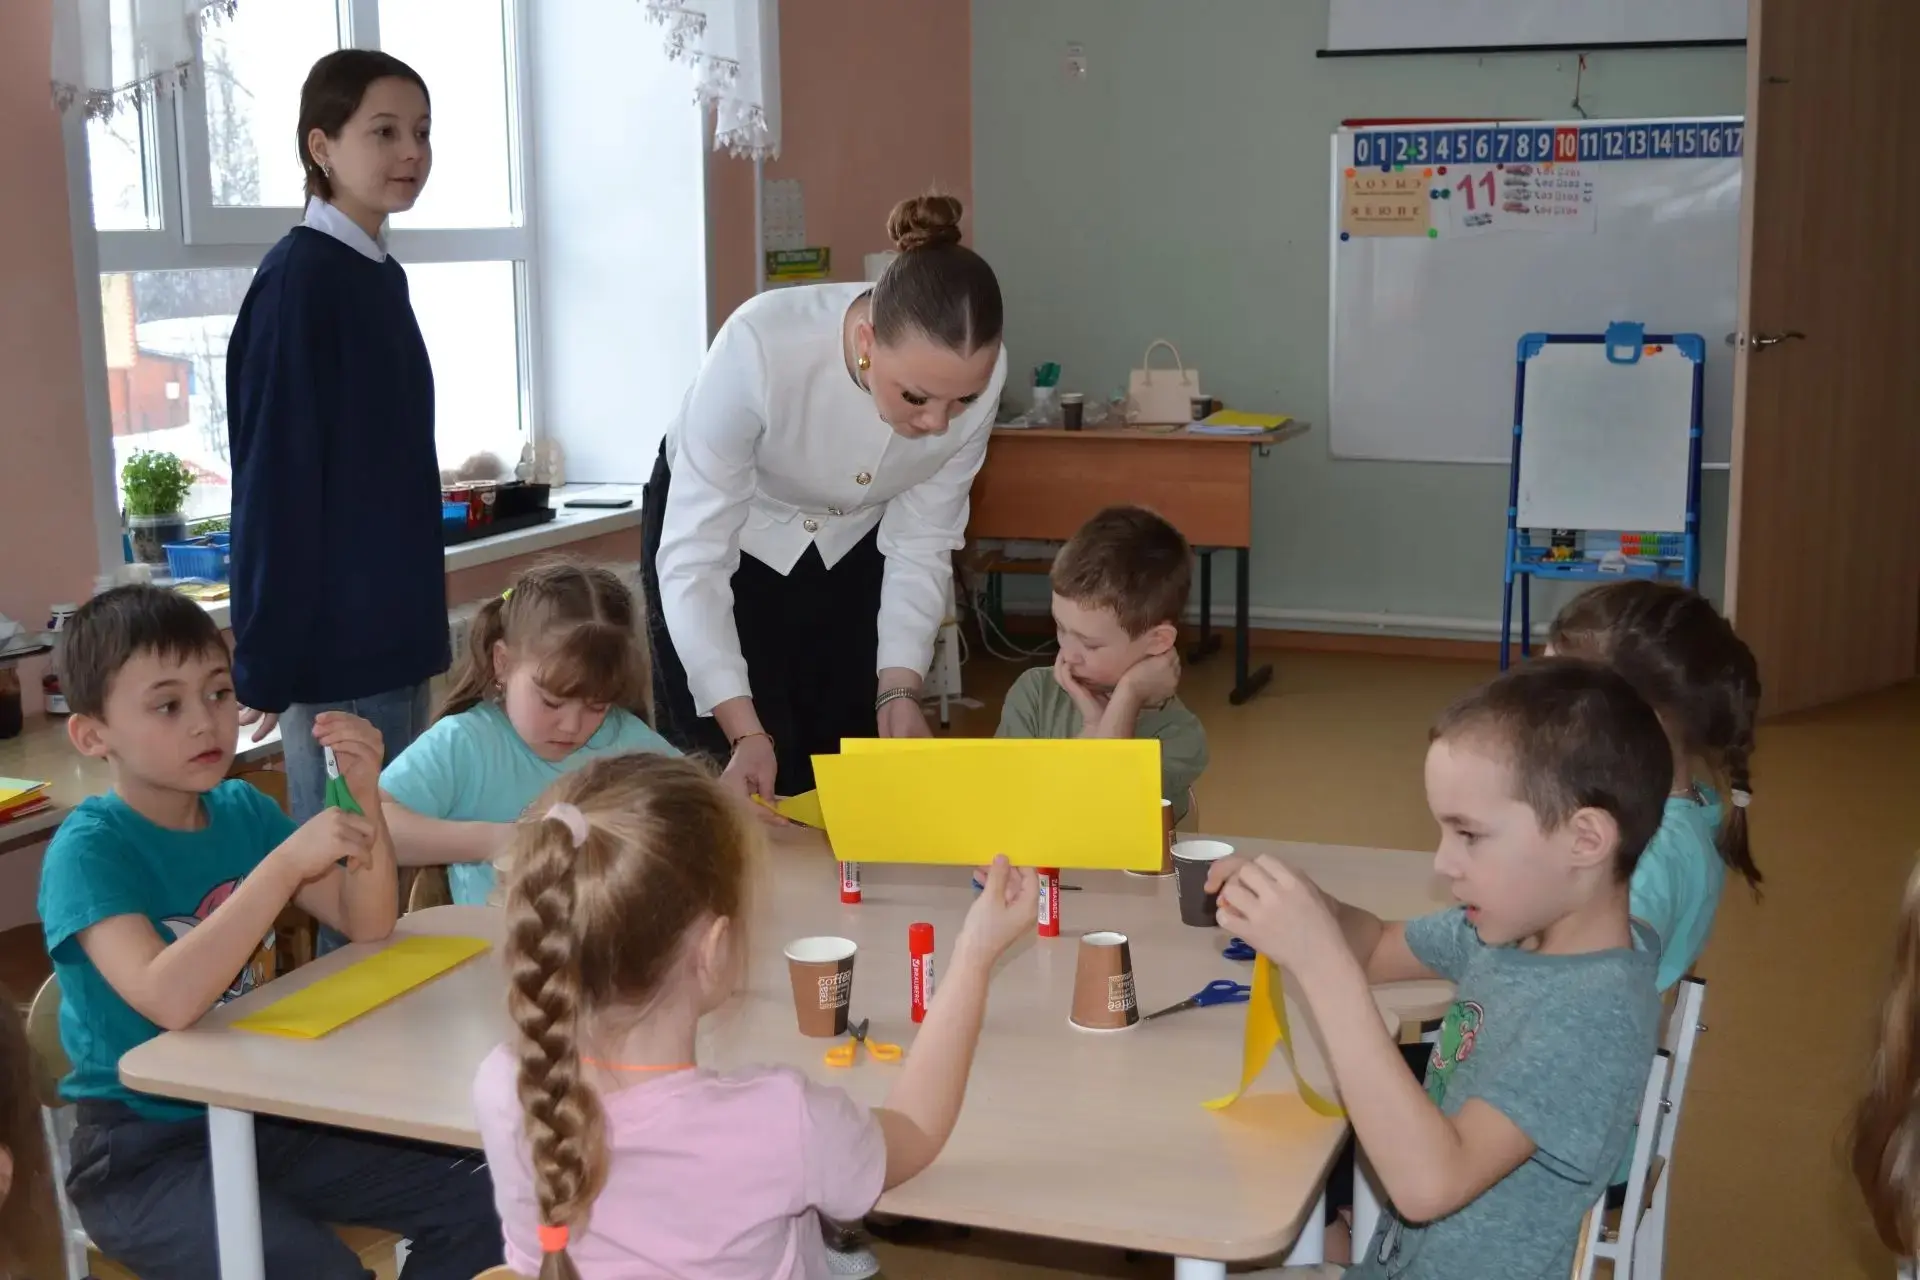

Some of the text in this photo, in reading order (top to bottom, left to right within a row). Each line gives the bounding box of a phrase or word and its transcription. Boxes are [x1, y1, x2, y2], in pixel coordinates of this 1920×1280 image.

[1356, 128, 1743, 162] 0 1 2 3 4 5 6 7 8 9 10 11 12 13 14 15 16 17
[1456, 171, 1496, 211] 11
[1108, 997, 1135, 1012] offee
